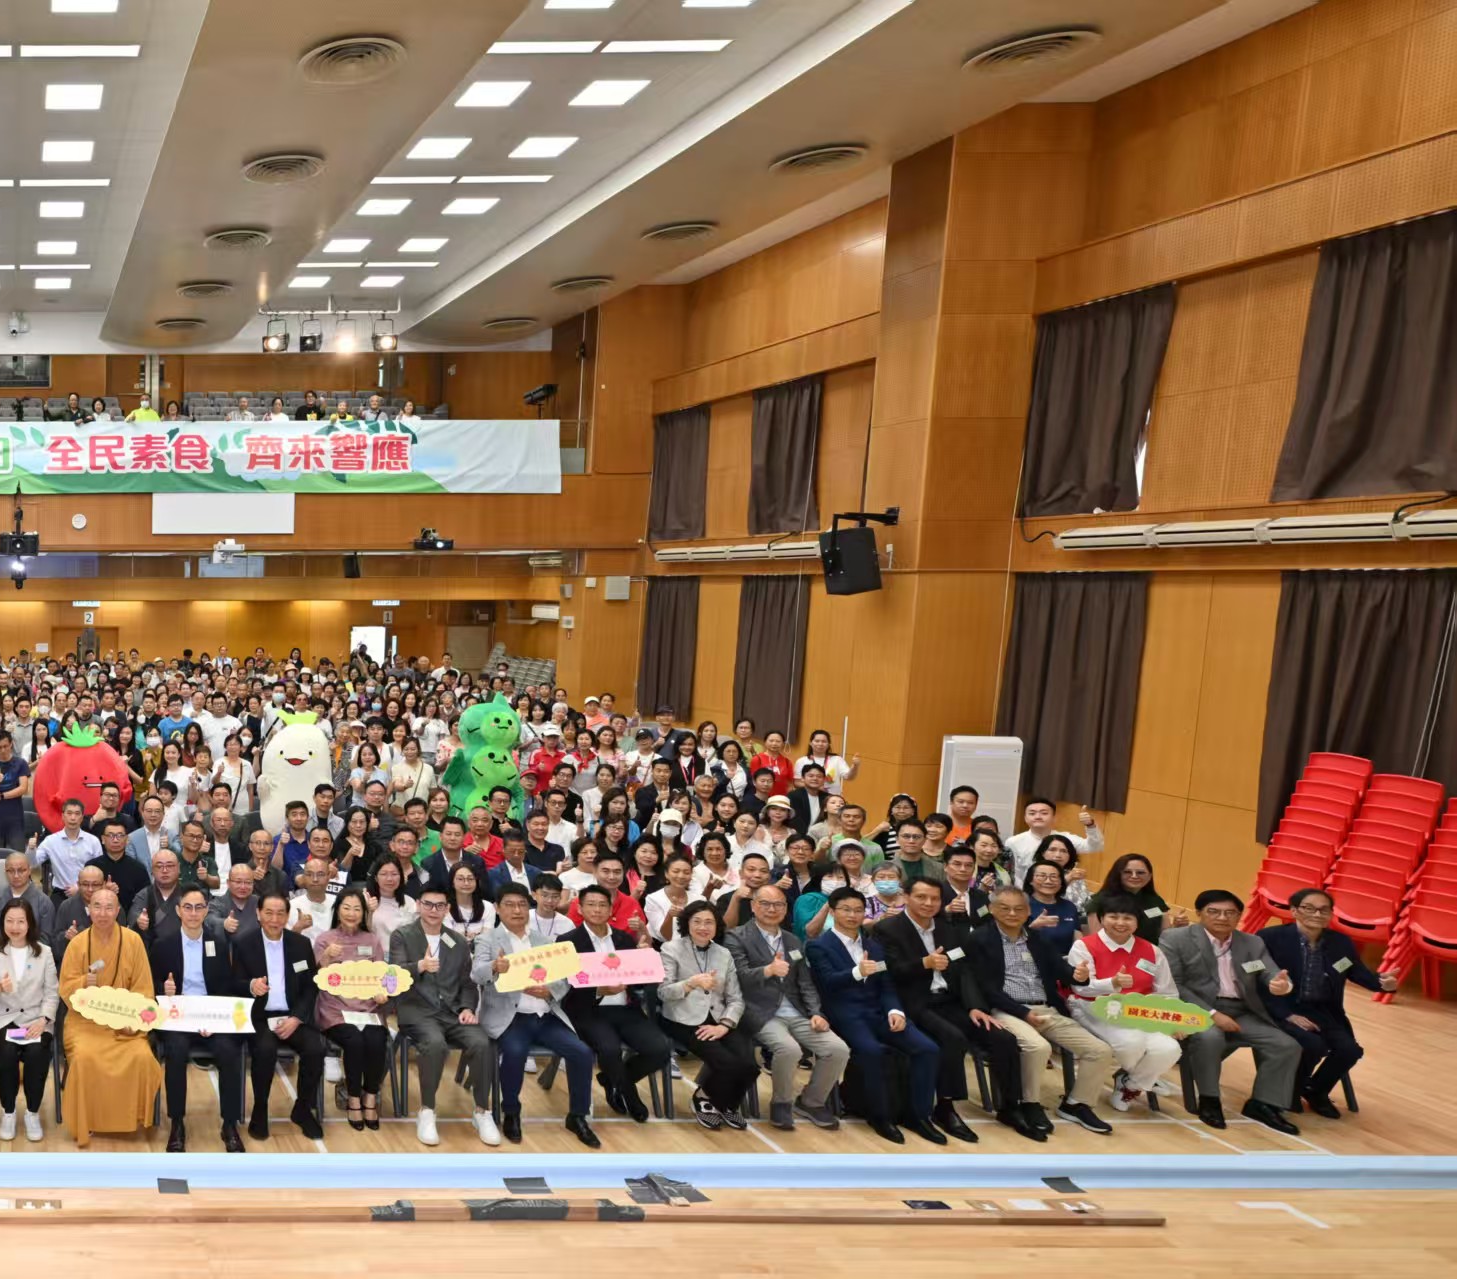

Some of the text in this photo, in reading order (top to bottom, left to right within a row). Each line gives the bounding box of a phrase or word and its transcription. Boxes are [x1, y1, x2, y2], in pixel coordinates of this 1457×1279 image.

[46, 434, 211, 471] 全民素食
[246, 433, 410, 471] 齊來響應
[86, 613, 92, 622] 2
